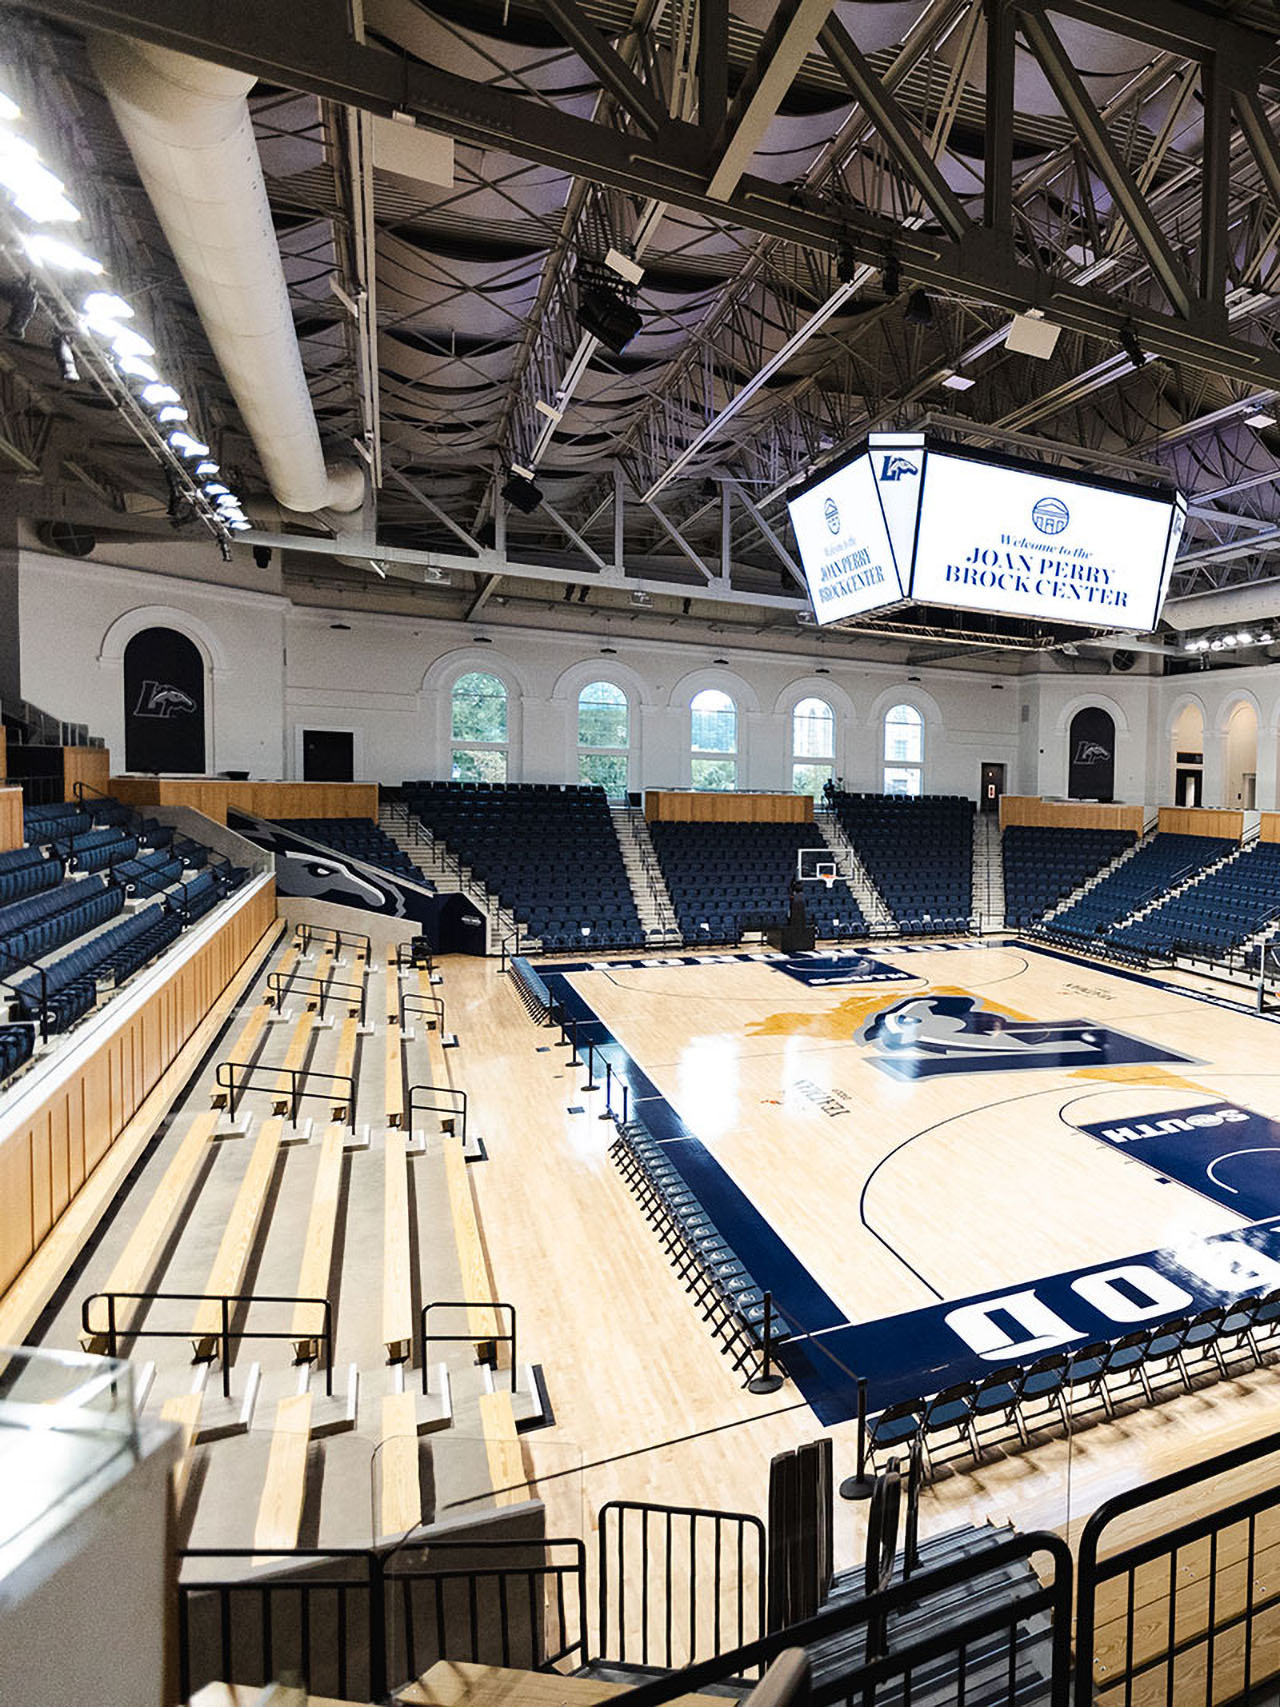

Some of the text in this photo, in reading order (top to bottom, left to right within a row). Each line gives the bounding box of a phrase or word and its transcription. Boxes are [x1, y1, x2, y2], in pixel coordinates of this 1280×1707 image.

[1000, 533, 1058, 554] Welcome
[966, 547, 1117, 585] JOAN PERRY
[945, 564, 1129, 608] BROCK CENTER
